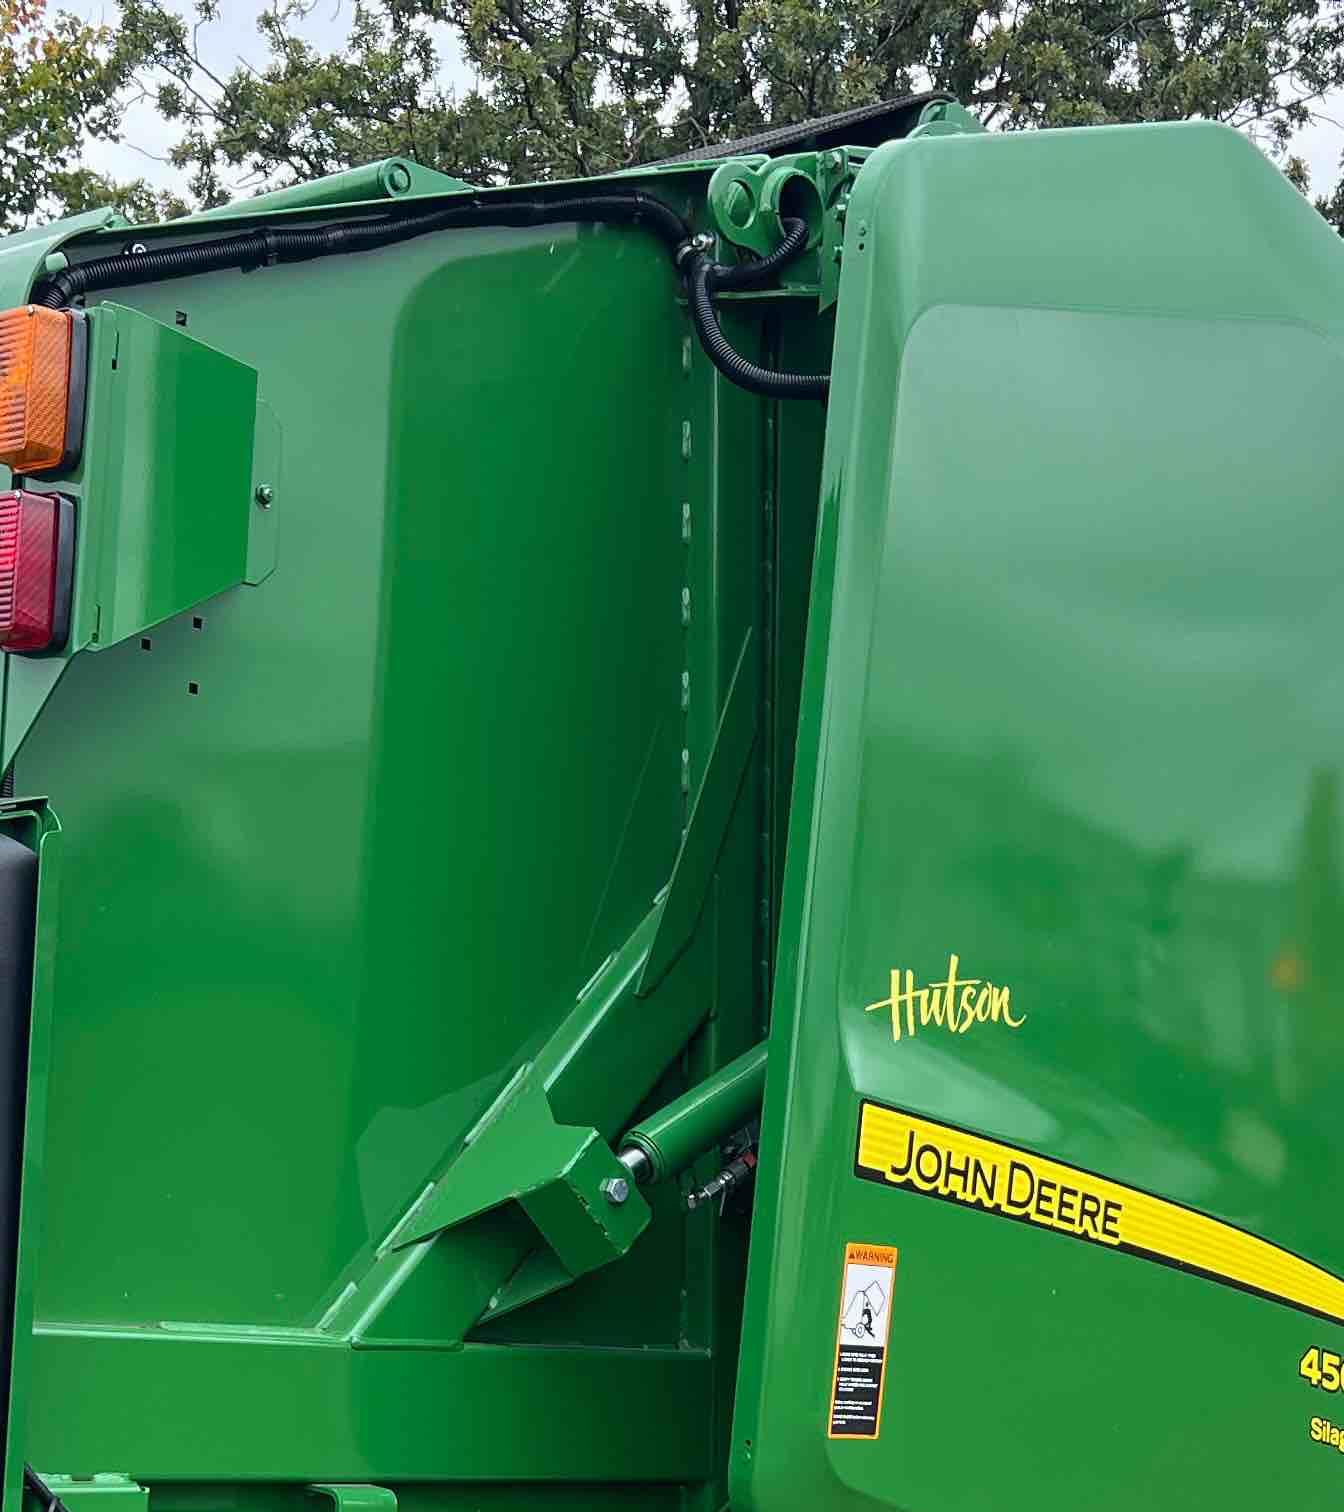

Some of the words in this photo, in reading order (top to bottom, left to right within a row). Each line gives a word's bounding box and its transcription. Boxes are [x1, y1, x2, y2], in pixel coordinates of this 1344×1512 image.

[864, 953, 1028, 1043] Hutson
[890, 1130, 998, 1202] JOHN
[1006, 1159, 1124, 1240] DEERE
